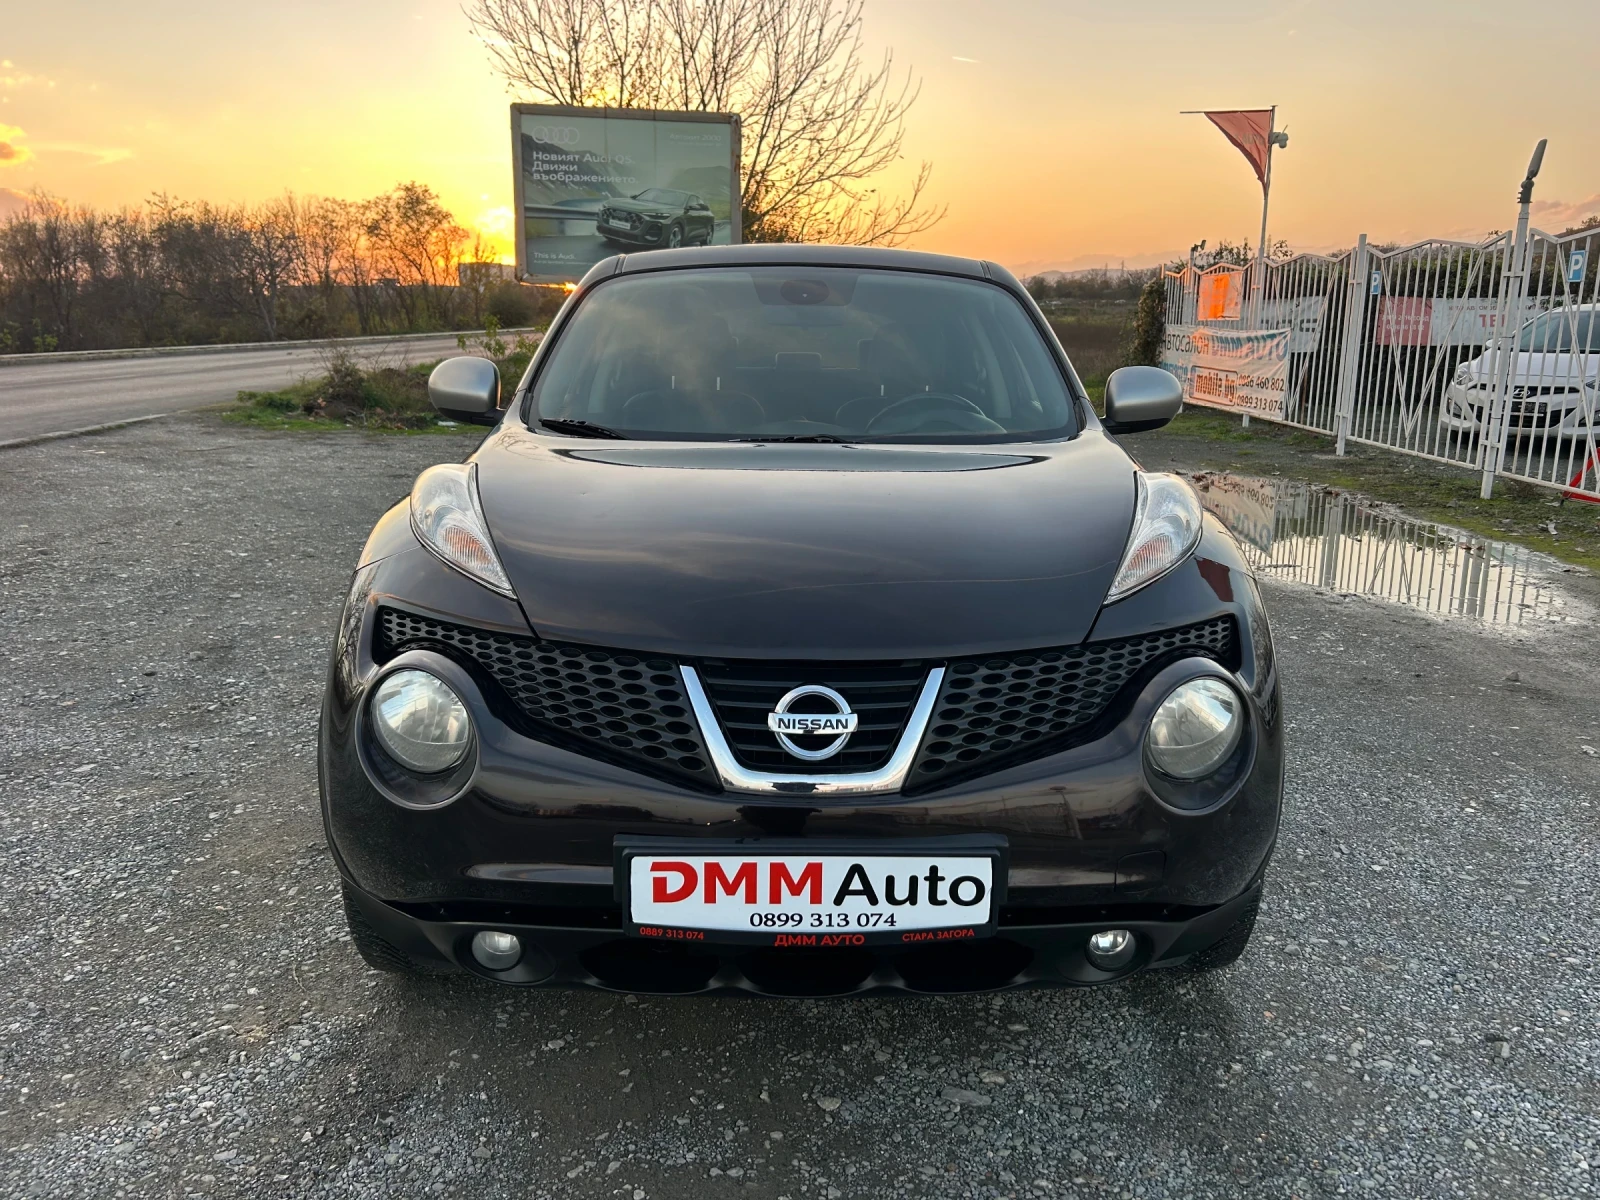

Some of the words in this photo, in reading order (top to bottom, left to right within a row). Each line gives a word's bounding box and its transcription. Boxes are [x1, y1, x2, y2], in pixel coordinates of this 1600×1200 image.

[533, 151, 580, 162] Новият
[583, 153, 611, 163] Audi
[532, 161, 578, 172] Движи
[533, 172, 639, 184] въображението.
[1569, 255, 1584, 279] P
[1372, 273, 1380, 292] P
[1195, 371, 1236, 402] mobile.bg
[1255, 375, 1269, 390] 460
[1271, 378, 1285, 392] 802
[1254, 397, 1267, 411] 313
[1269, 399, 1283, 413] 074
[778, 718, 848, 730] NISSAN
[650, 861, 823, 904] DMM
[832, 863, 986, 907] Auto
[749, 912, 803, 928] 0899
[810, 912, 849, 928] 313
[856, 912, 897, 928] 074
[639, 927, 663, 937] 0889
[666, 929, 682, 939] 313
[684, 931, 704, 940] 074
[774, 934, 816, 947] ДММ
[820, 934, 865, 946] АУТО
[902, 932, 934, 942] СТАРА
[937, 929, 975, 939] ЗАГОРА
